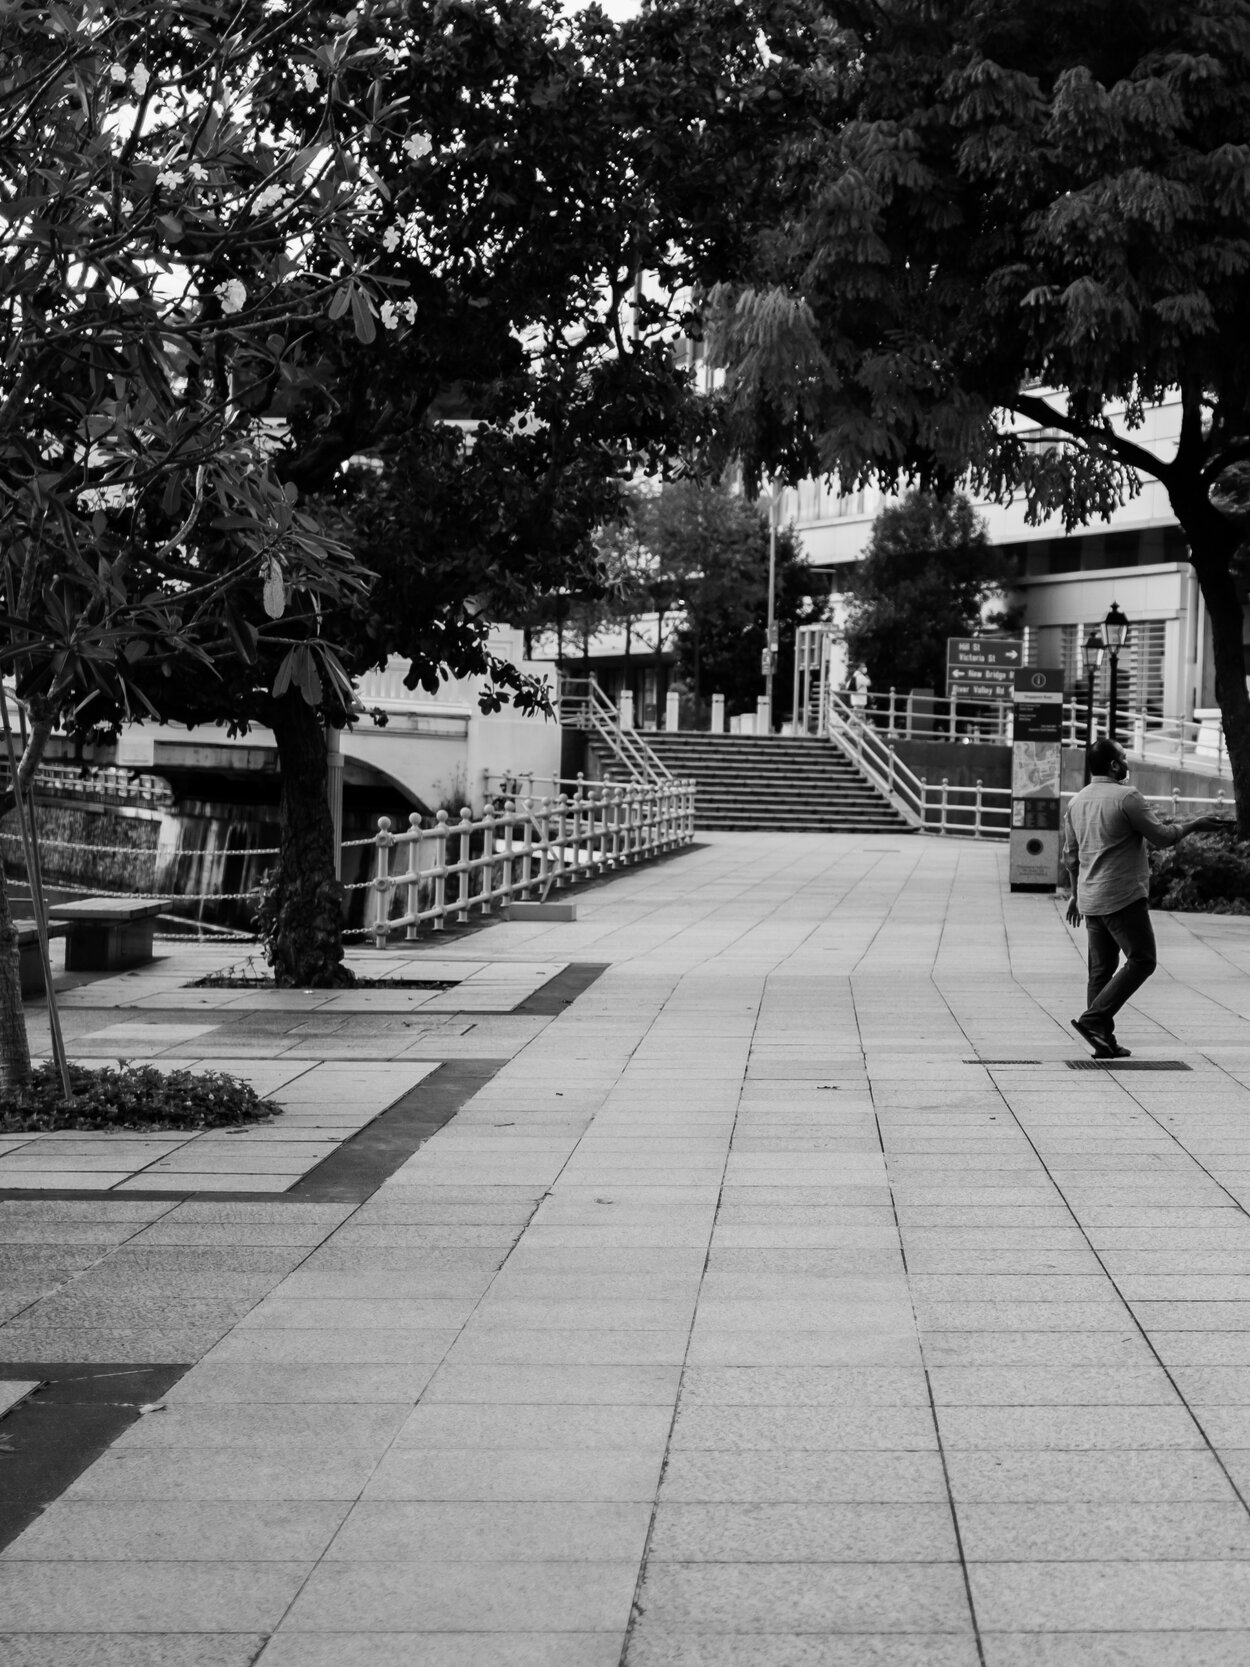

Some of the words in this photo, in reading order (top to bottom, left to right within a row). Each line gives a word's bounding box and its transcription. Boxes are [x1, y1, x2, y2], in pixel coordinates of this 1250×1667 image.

[959, 643, 970, 651] Hill
[973, 643, 980, 651] St
[959, 653, 985, 662] Victoria
[988, 654, 995, 662] St
[968, 669, 982, 678] New
[986, 670, 1006, 680] Bridge
[973, 685, 993, 695] Valley
[996, 686, 1005, 695] Rd
